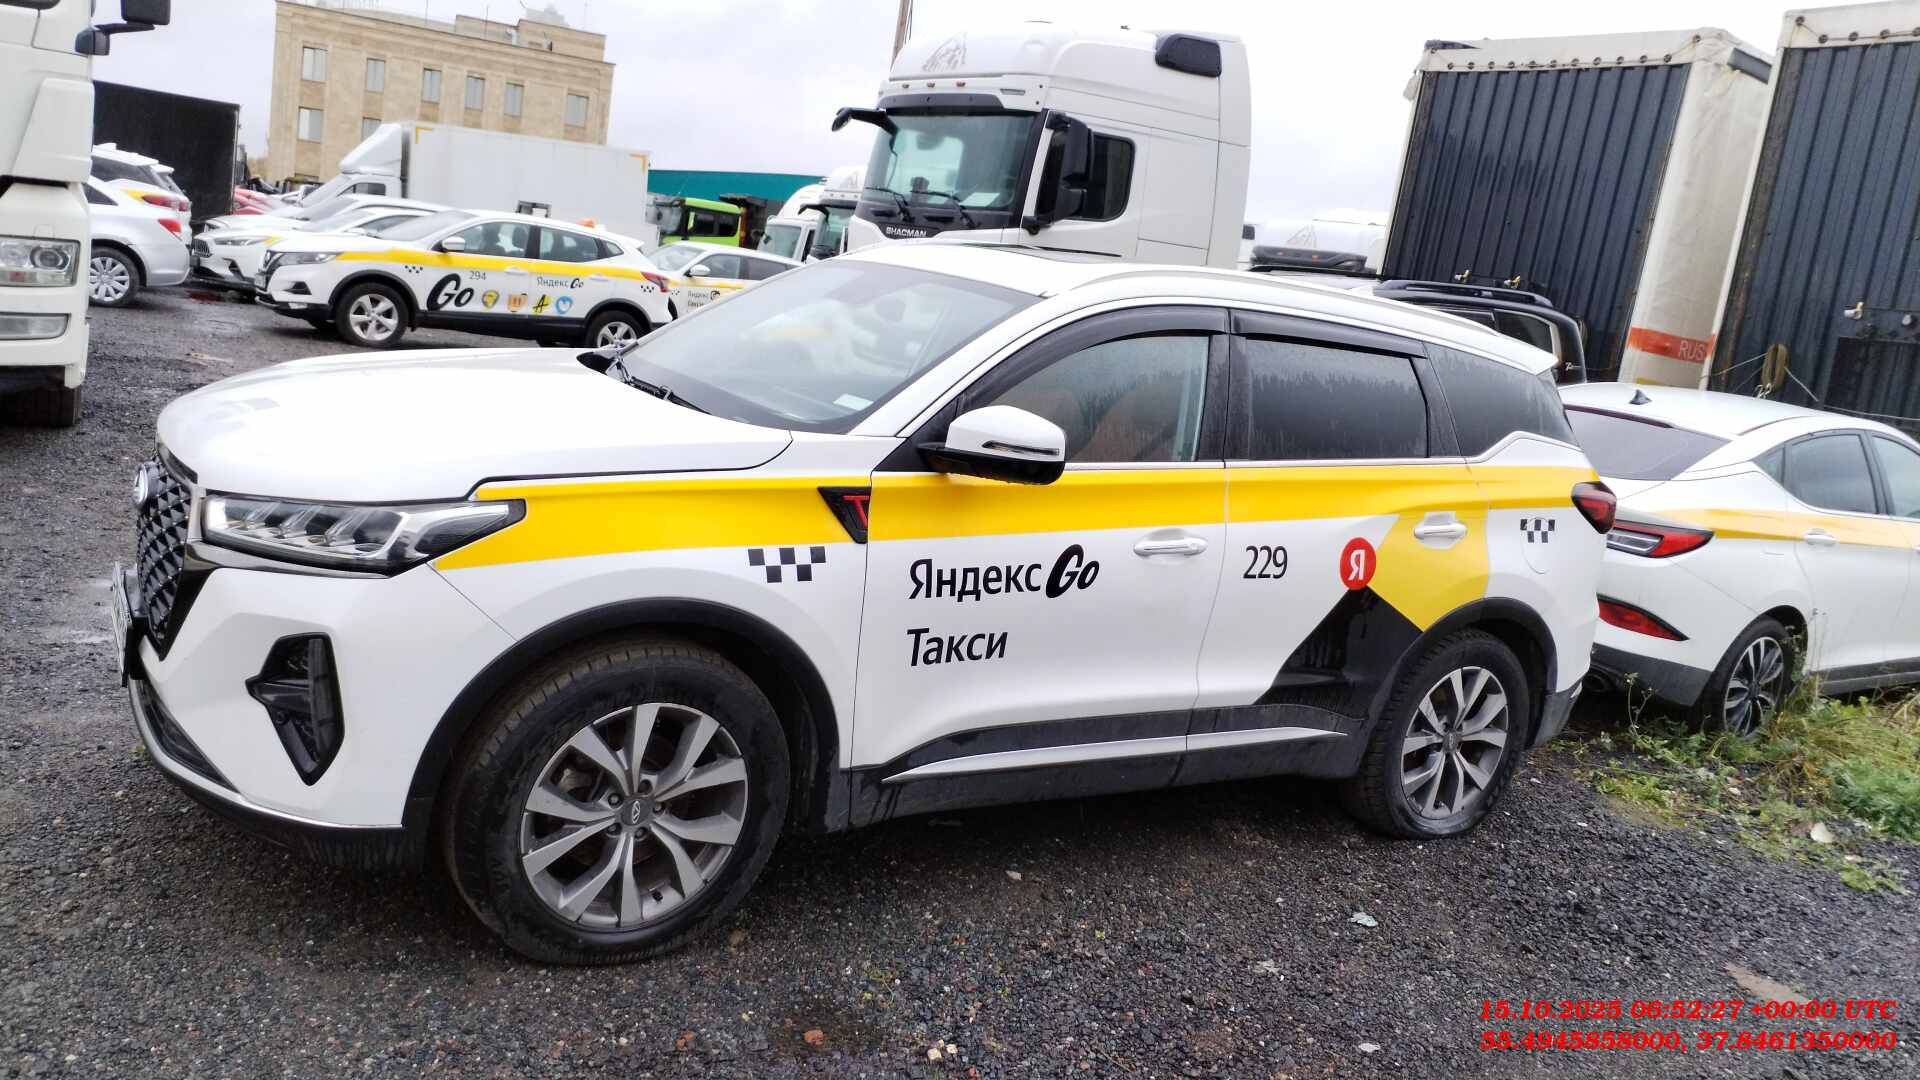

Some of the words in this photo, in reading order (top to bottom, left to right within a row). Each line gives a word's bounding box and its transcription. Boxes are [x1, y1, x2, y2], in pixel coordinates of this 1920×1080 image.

[886, 226, 927, 237] SHACMAN
[469, 270, 486, 280] 294
[537, 277, 568, 288] Яндекс
[570, 278, 584, 289] Go
[427, 273, 474, 311] Go
[909, 558, 1041, 602] Яндекс
[1045, 544, 1100, 598] Go
[1243, 545, 1288, 579] 229
[1348, 549, 1366, 581] Я
[907, 627, 1008, 666] Такси
